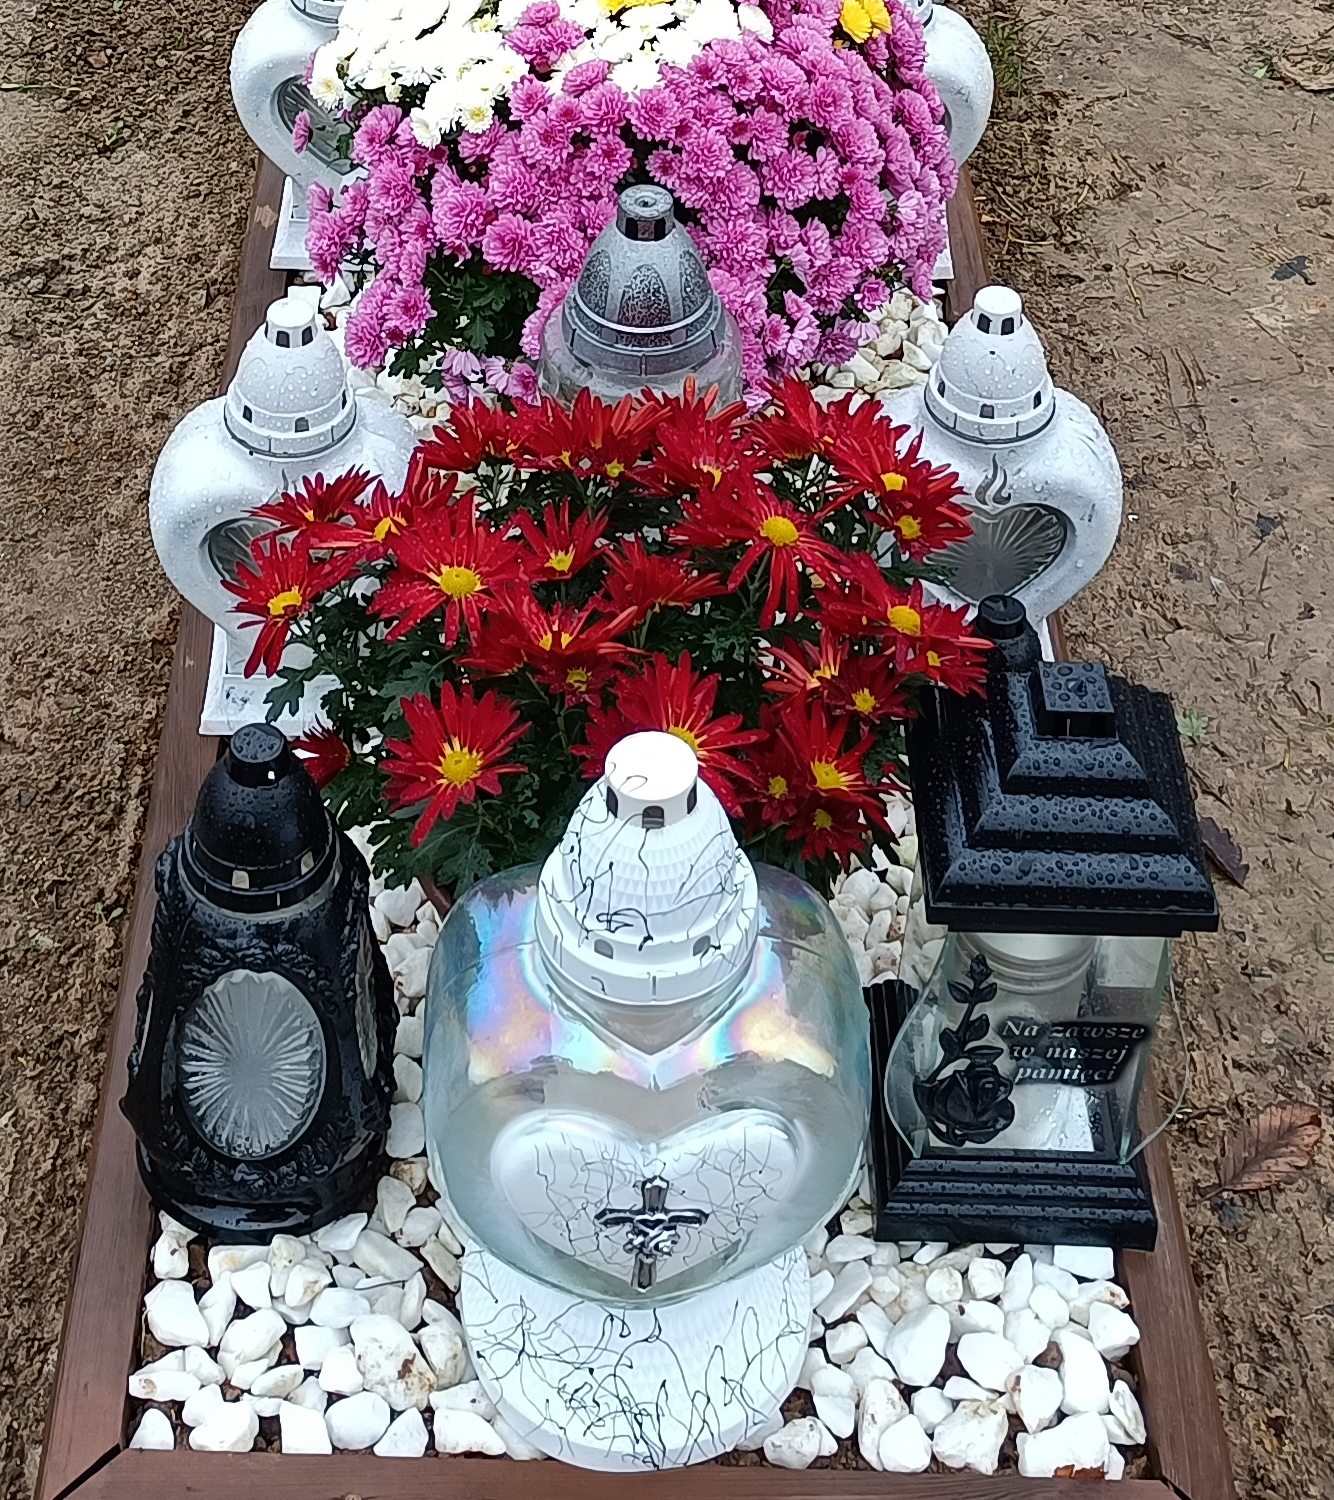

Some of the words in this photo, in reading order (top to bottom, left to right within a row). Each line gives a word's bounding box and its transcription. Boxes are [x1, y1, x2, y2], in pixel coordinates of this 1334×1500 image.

[1002, 1020, 1038, 1036] Na
[1049, 1026, 1145, 1039] zawsze
[1013, 1046, 1035, 1057] w
[1046, 1044, 1128, 1064] naszej
[1014, 1065, 1116, 1084] pamięci
